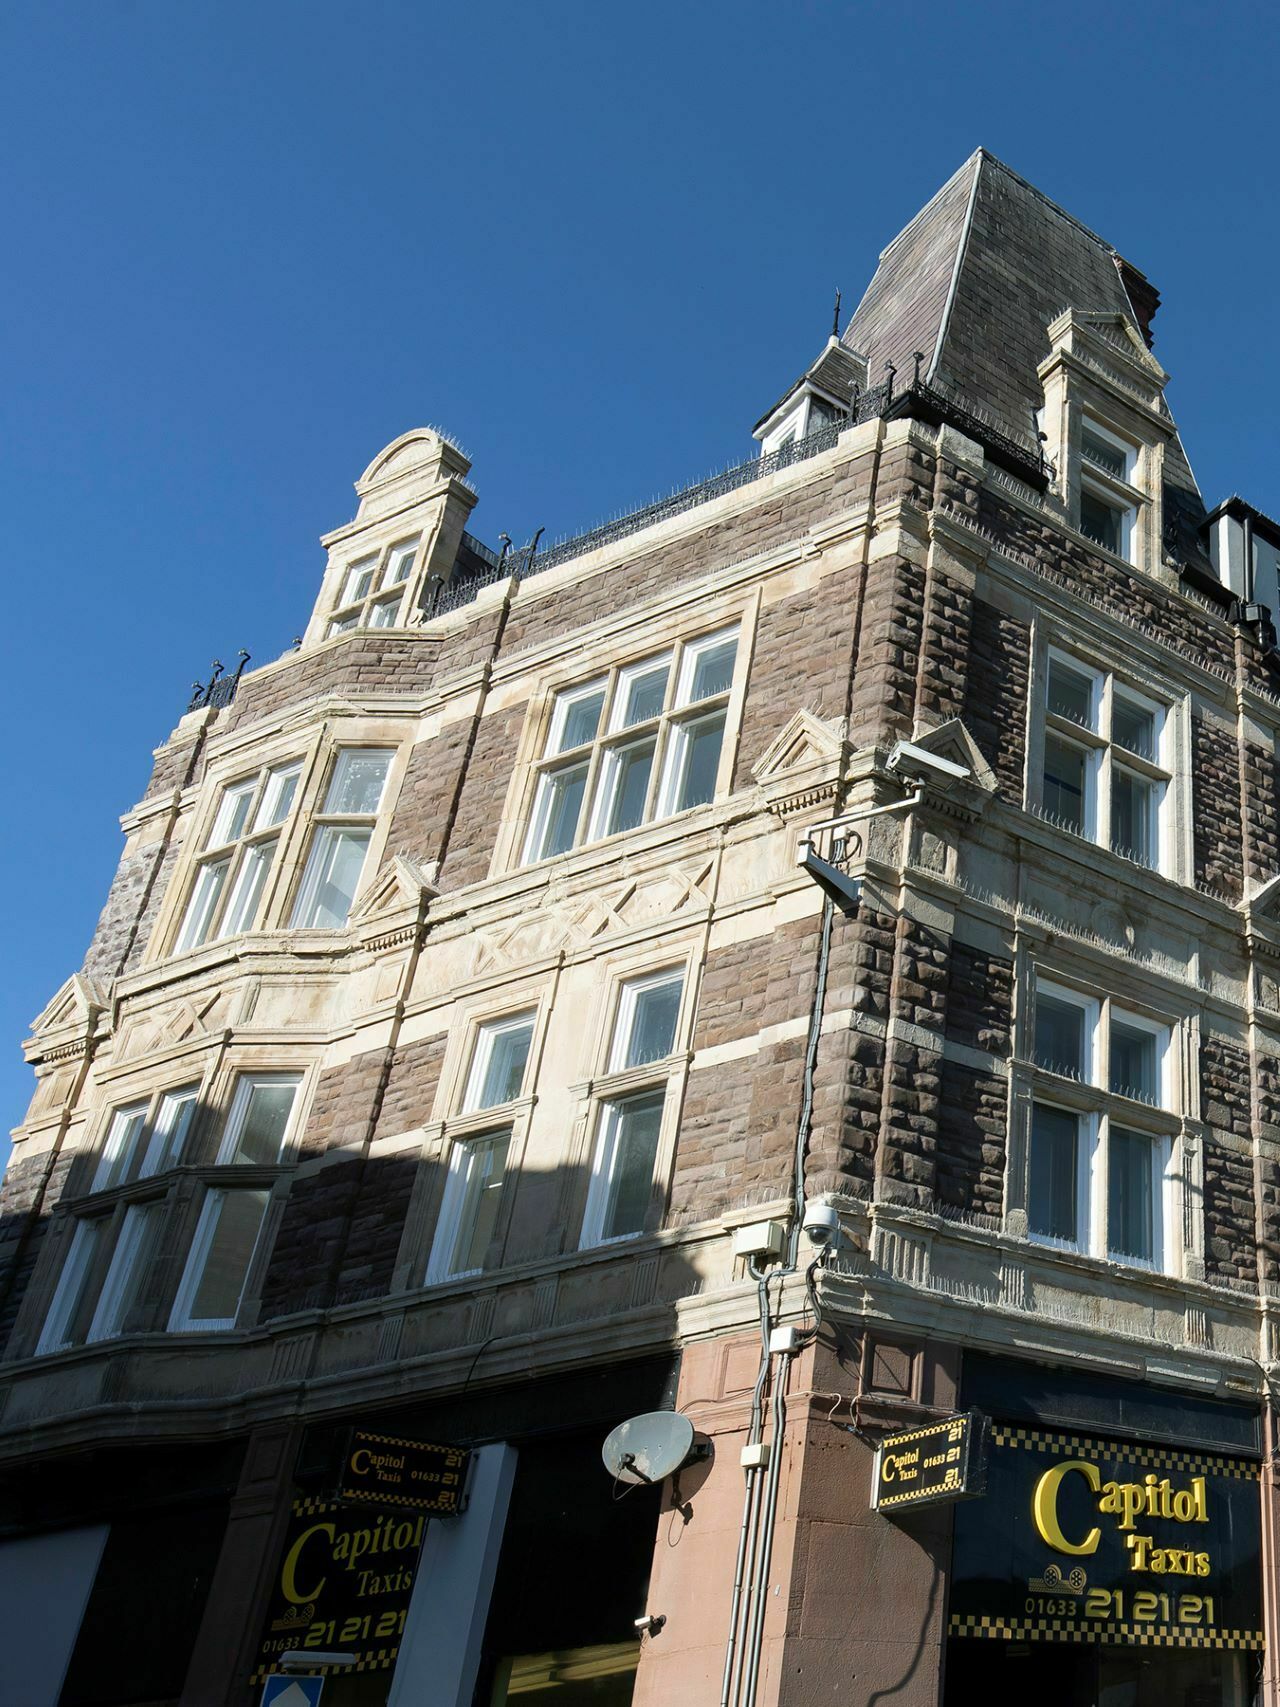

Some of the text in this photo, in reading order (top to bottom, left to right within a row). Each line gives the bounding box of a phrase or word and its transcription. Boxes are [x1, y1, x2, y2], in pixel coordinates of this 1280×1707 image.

[948, 1426, 963, 1442] 21
[350, 1449, 406, 1476] Capitol
[444, 1454, 463, 1469] 21
[882, 1448, 920, 1482] Capitol
[923, 1446, 961, 1469] 01633 21
[376, 1470, 402, 1483] Taxis
[410, 1470, 459, 1486] 01633 21
[899, 1467, 918, 1481] Taxis
[944, 1467, 959, 1483] 21
[438, 1490, 456, 1504] 21
[1034, 1460, 1209, 1556] Capitol
[281, 1515, 425, 1605] Capitol
[1127, 1534, 1211, 1577] Taxis
[355, 1563, 413, 1597] Taxis
[1025, 1588, 1214, 1624] 01633 21 21 21
[262, 1609, 407, 1653] 01633 21 21 21
